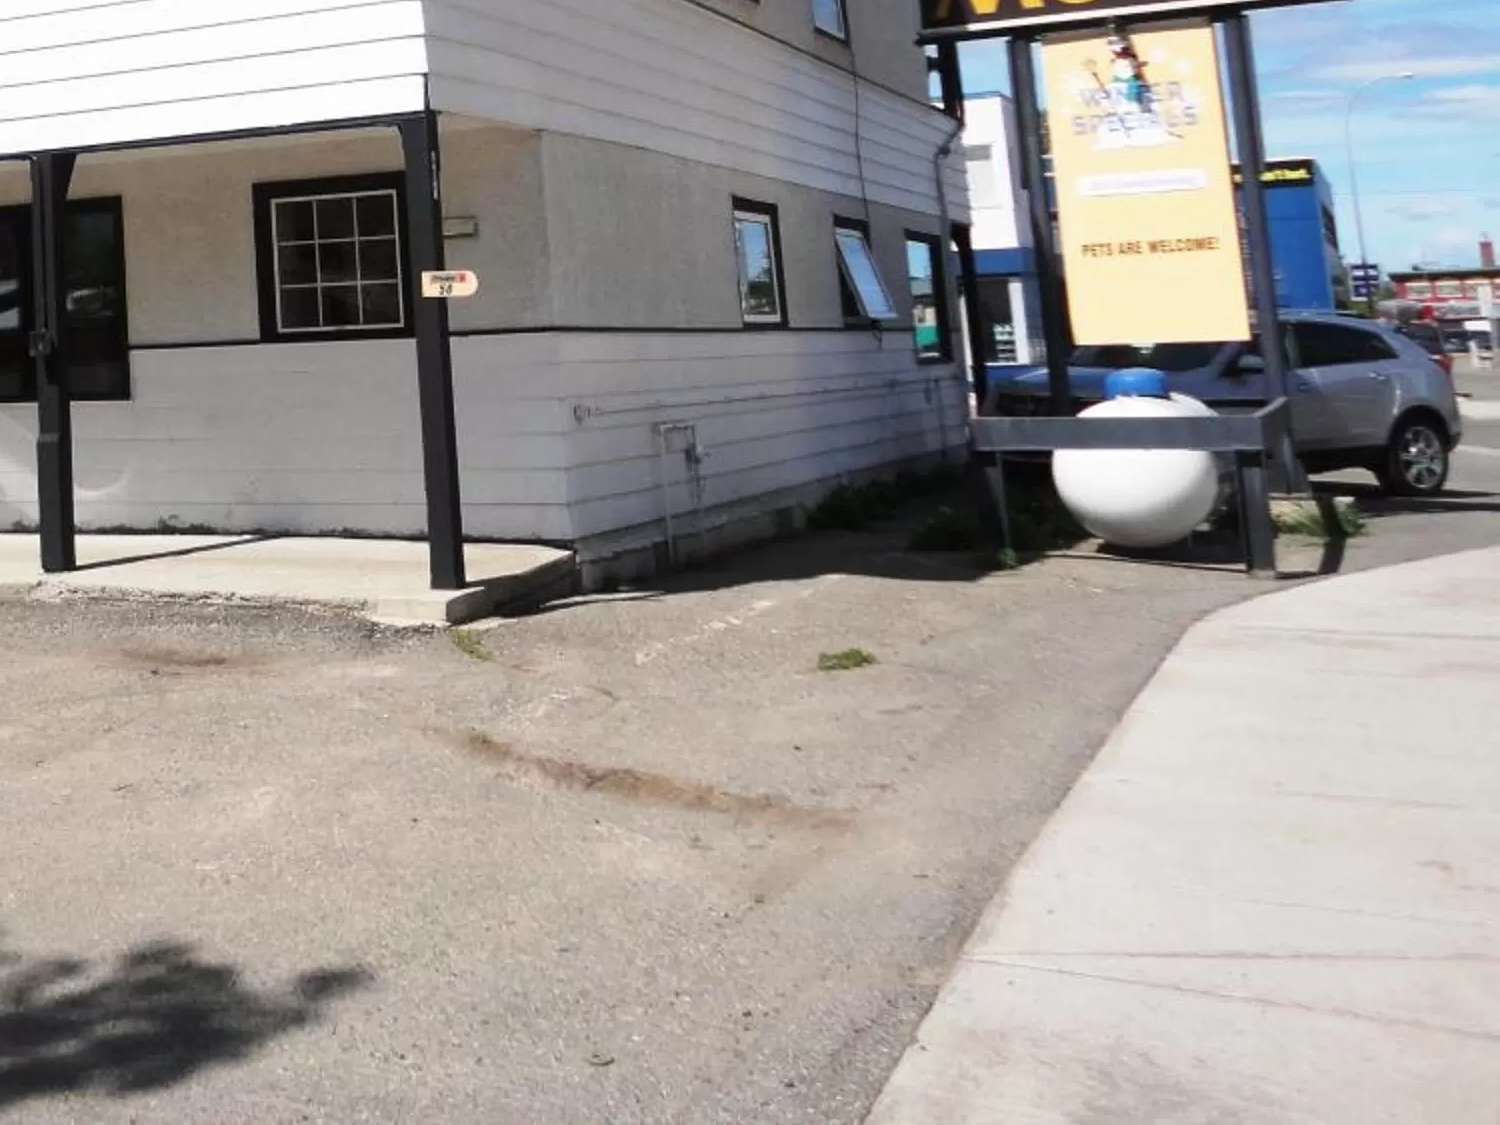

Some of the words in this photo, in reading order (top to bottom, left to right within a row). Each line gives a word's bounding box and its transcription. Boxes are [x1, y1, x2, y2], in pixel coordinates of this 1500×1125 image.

[1079, 81, 1184, 108] WER
[1072, 105, 1198, 136] SPECLS
[1080, 242, 1113, 259] PETS
[1118, 240, 1143, 256] ARE
